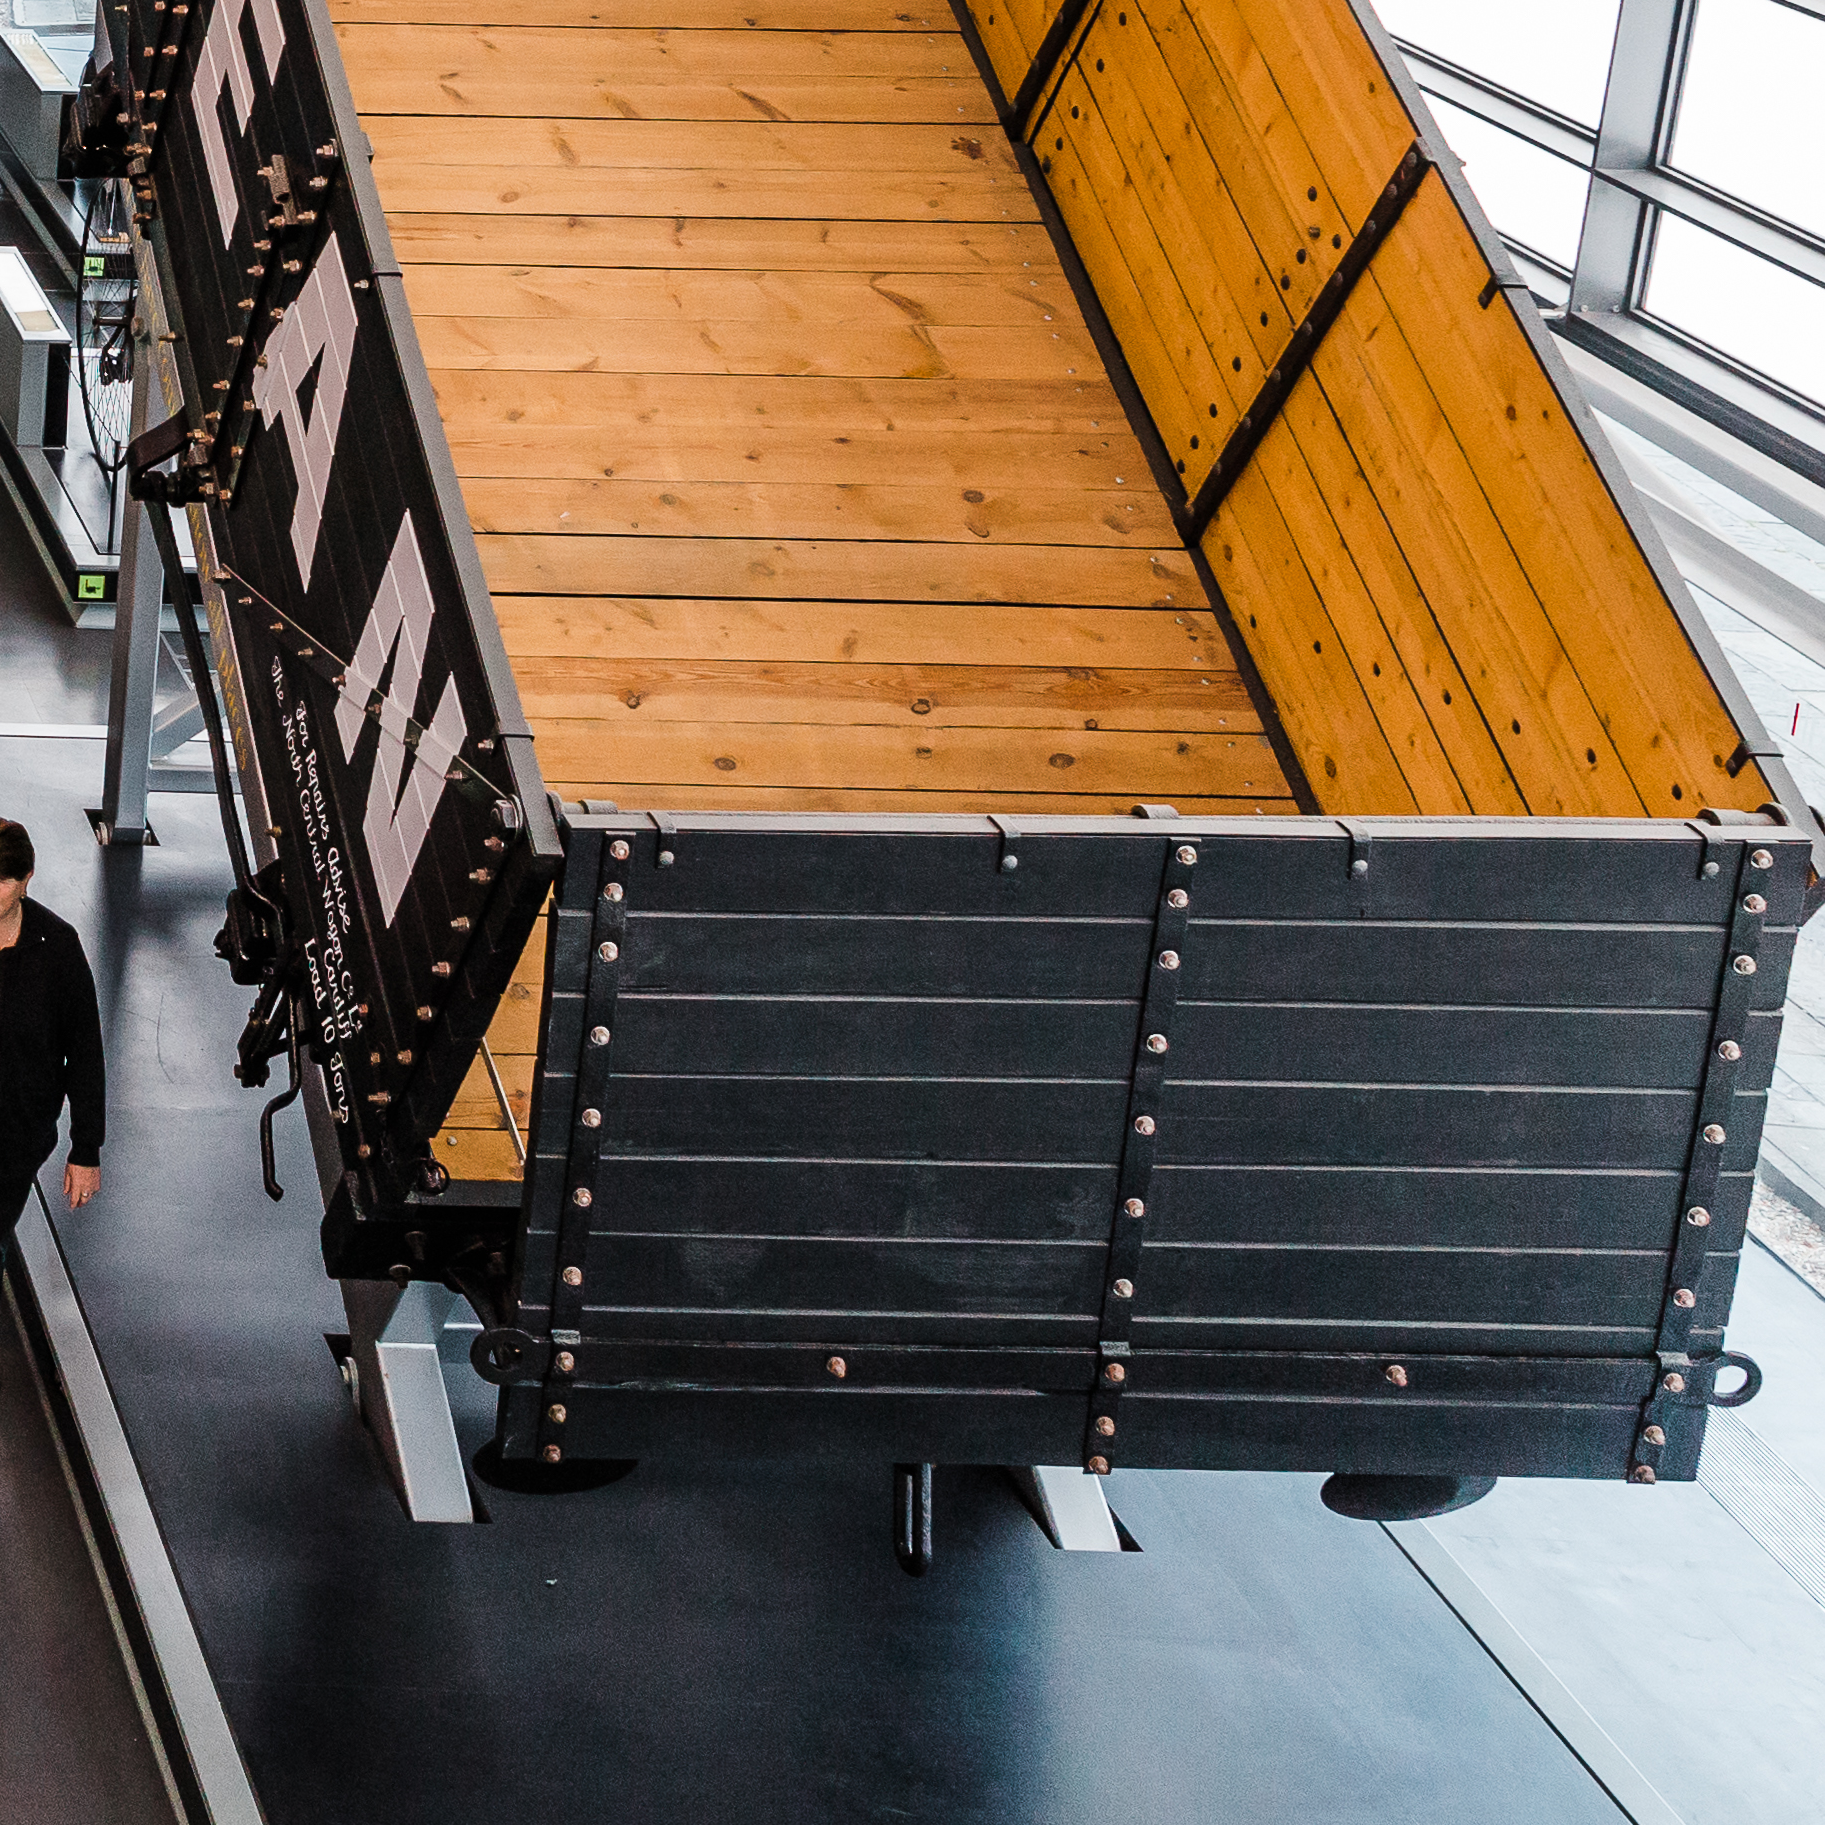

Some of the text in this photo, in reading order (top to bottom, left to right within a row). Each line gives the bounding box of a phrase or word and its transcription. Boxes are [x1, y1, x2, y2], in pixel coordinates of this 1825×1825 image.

[271, 655, 284, 708] The
[282, 714, 303, 787] North
[299, 789, 326, 880] Central
[305, 748, 329, 841] Repairs
[304, 937, 349, 1124] Load 10 Tons
[323, 947, 353, 1039] Cardiff
